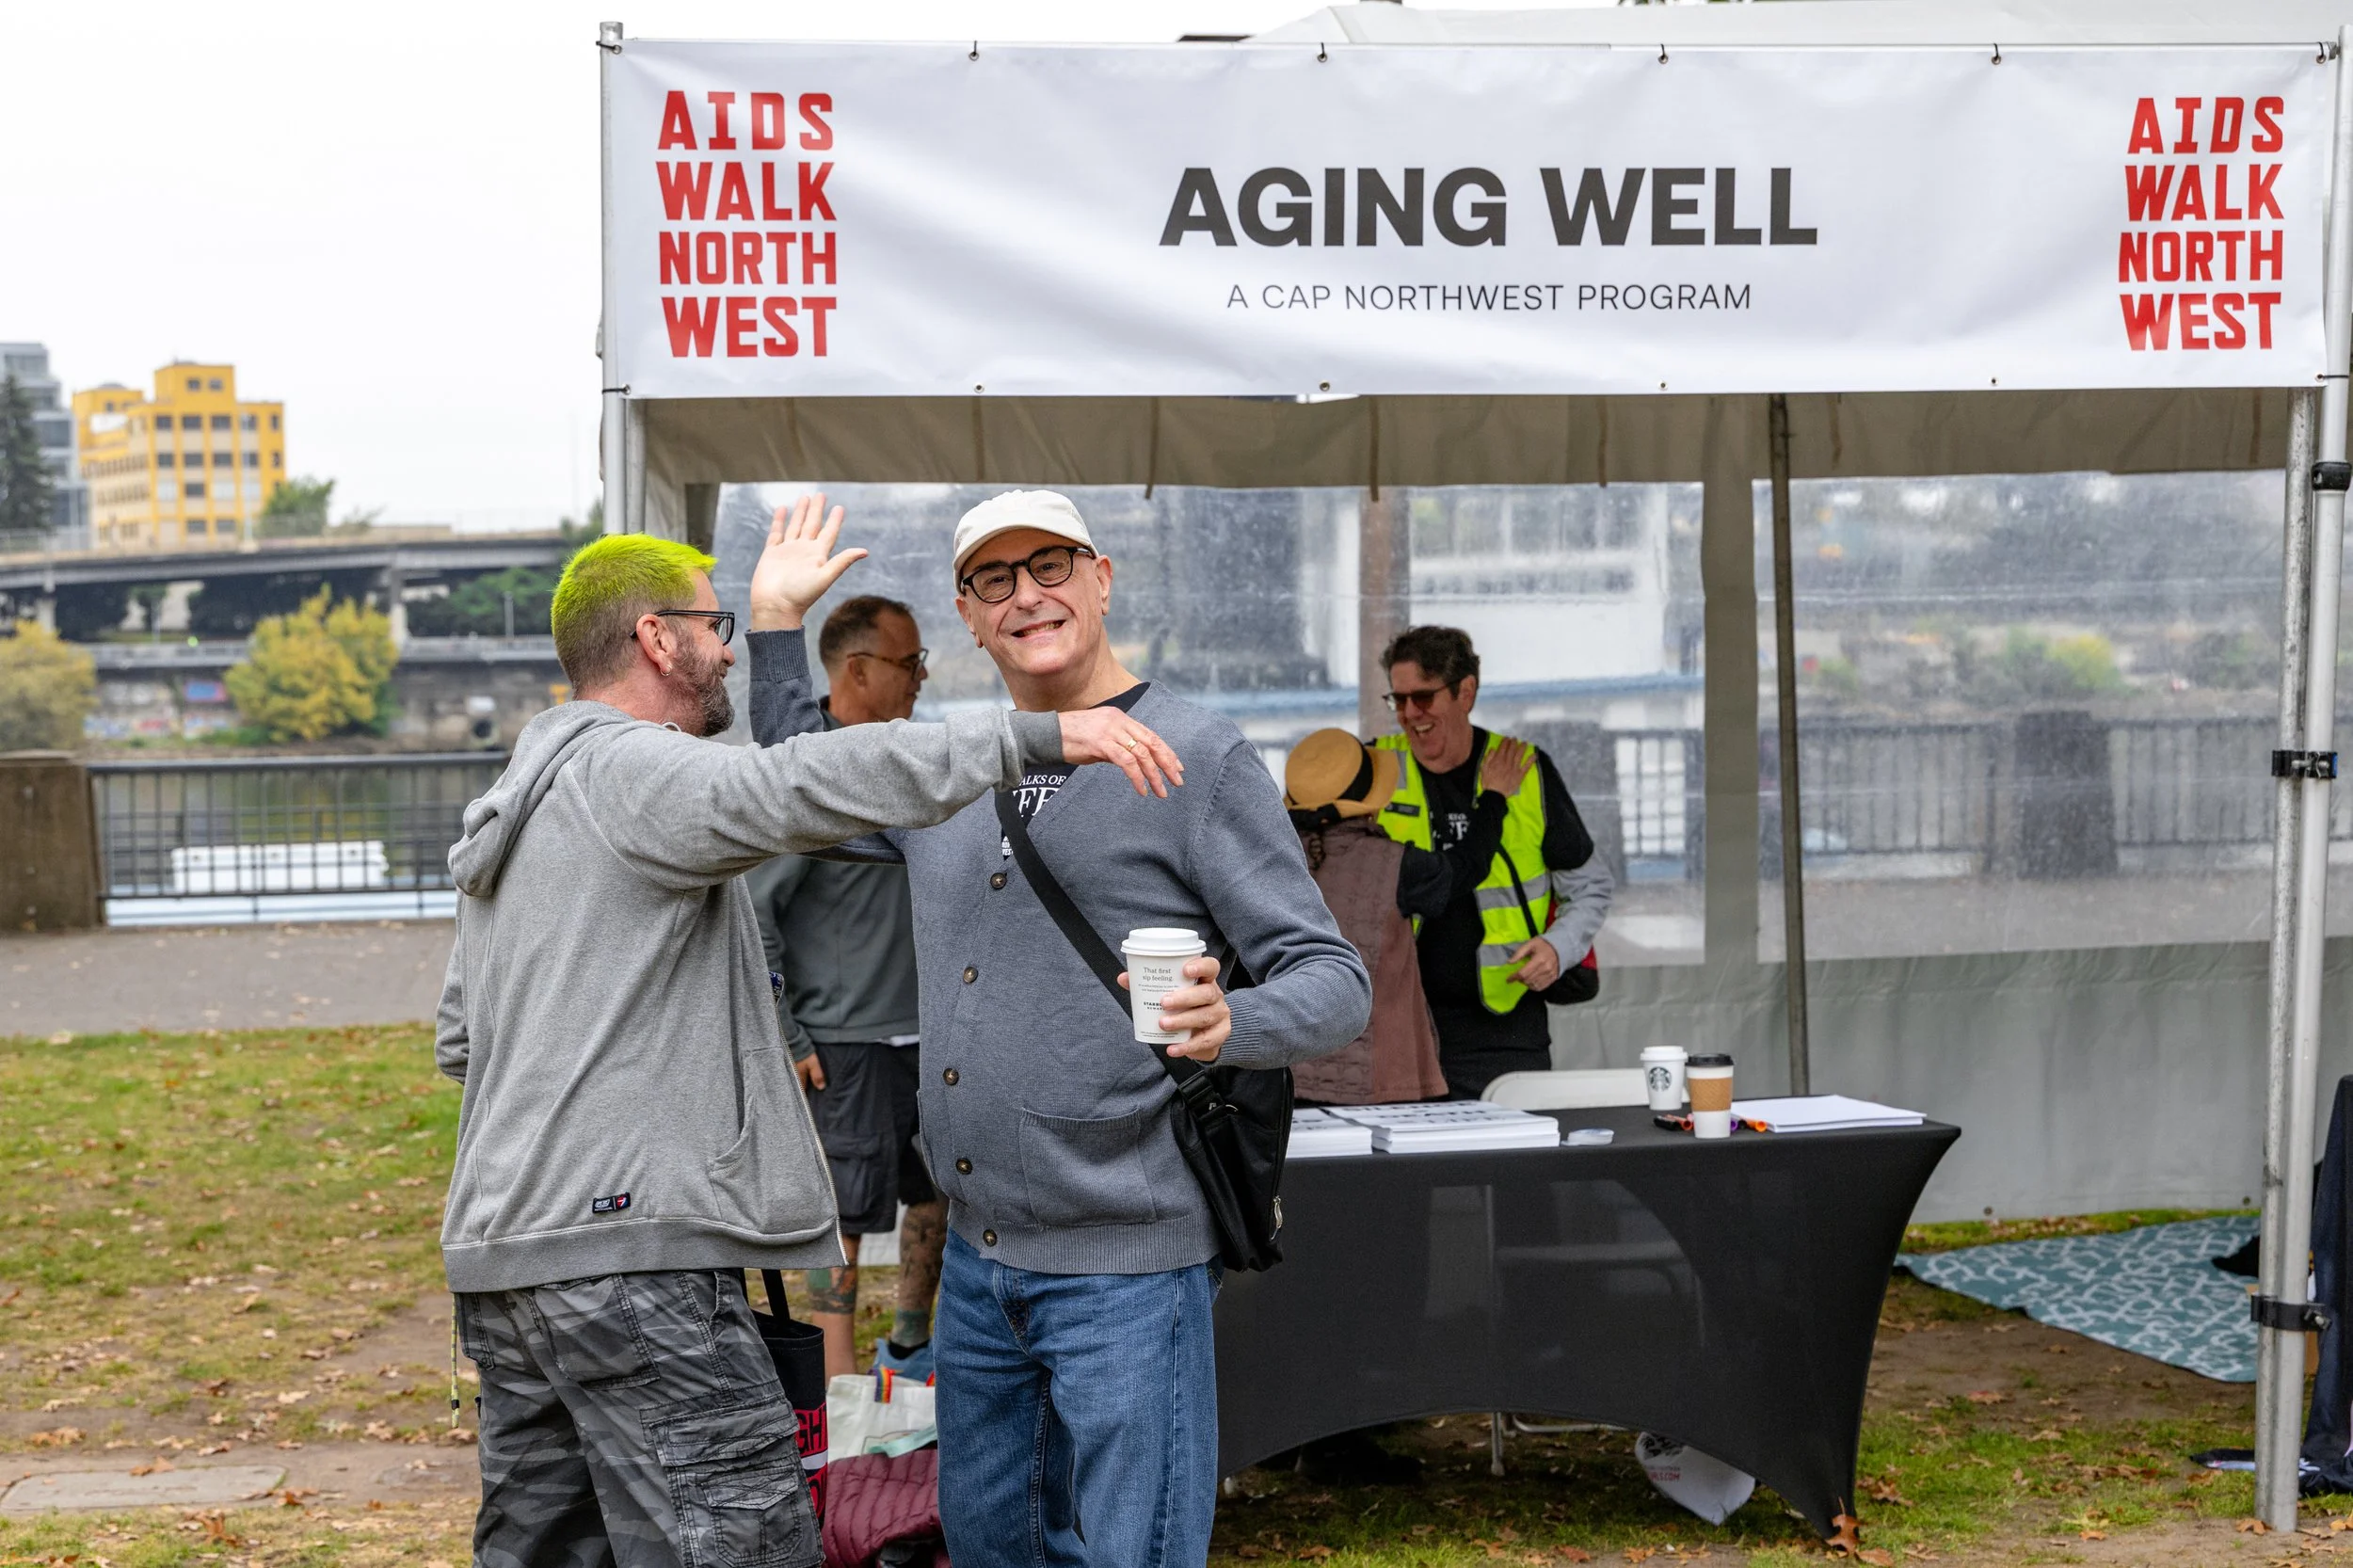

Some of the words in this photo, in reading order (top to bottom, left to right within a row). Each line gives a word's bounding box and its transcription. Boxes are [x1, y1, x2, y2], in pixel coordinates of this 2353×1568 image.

[658, 90, 833, 151] AIDS
[2128, 97, 2284, 154] AIDS
[656, 162, 837, 221] WALK
[1159, 167, 1507, 247] AGING
[1540, 167, 1817, 247] WELL
[2124, 164, 2284, 222] WALK
[659, 232, 837, 285] NORTH
[2119, 230, 2283, 283] NORTH
[1226, 284, 1249, 310] A
[1262, 284, 1331, 311] CAP
[1345, 284, 1564, 311] NORTHWEST
[1578, 284, 1751, 311] PROGRAM
[2120, 292, 2281, 351] WEST
[662, 296, 837, 358] WEST
[1019, 775, 1048, 786] ALKS
[1048, 775, 1066, 786] OF
